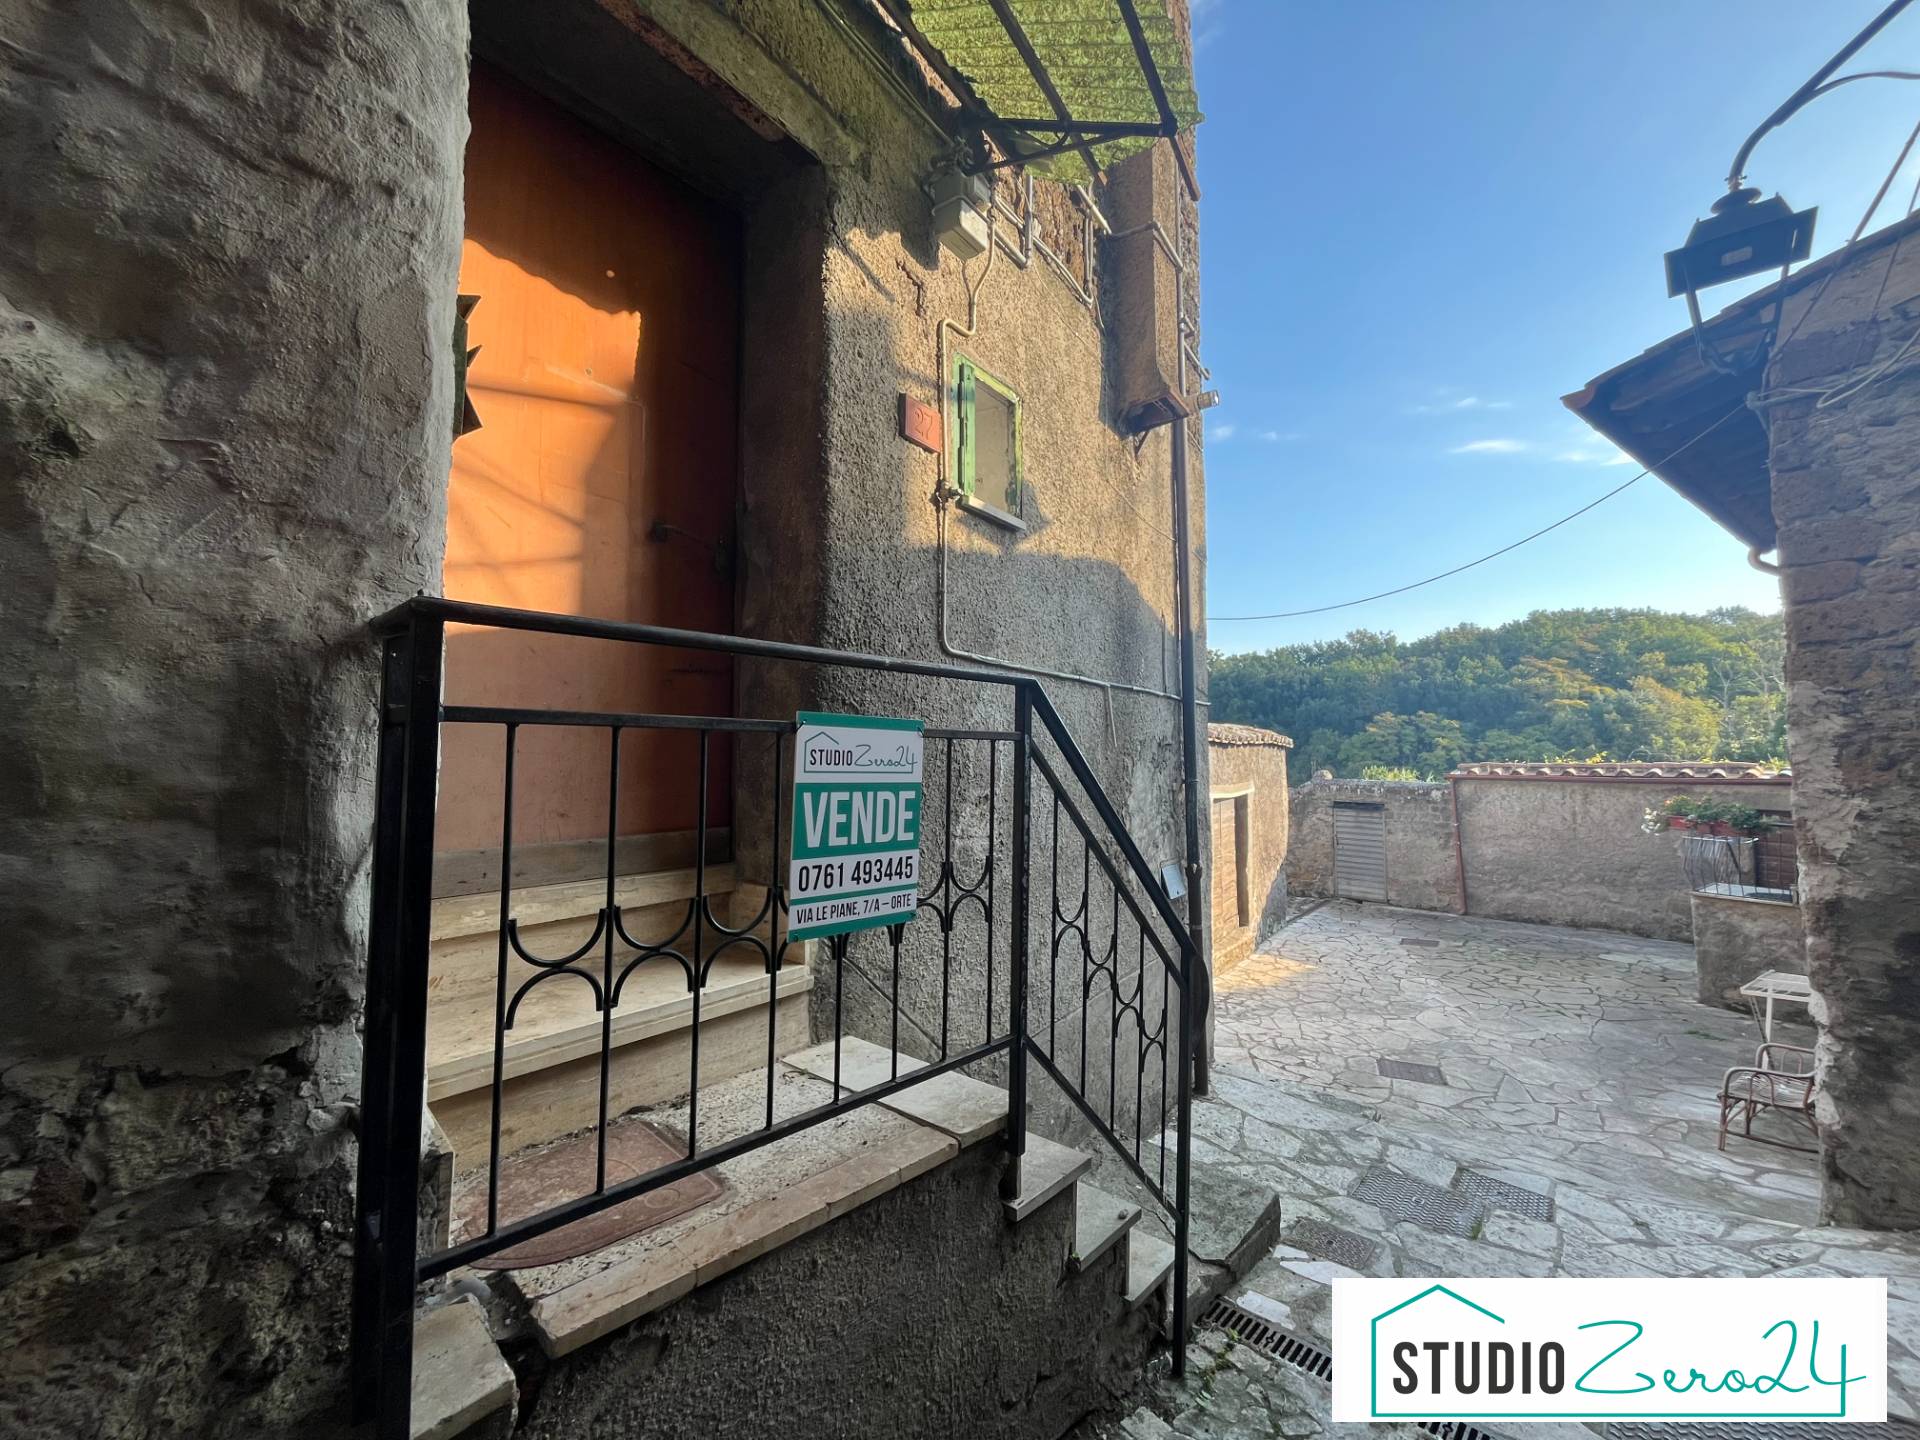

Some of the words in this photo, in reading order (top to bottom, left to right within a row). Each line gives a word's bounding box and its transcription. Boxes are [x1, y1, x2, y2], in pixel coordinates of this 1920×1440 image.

[913, 406, 934, 441] 27
[809, 749, 853, 767] STUDIO
[803, 790, 916, 848] VENDE
[798, 862, 844, 892] 0761
[851, 855, 913, 885] 493445
[796, 907, 813, 925] VIA
[816, 905, 828, 921] LE
[830, 901, 860, 919] PIANE,
[863, 897, 880, 914] 7/A
[891, 893, 912, 909] ORTE
